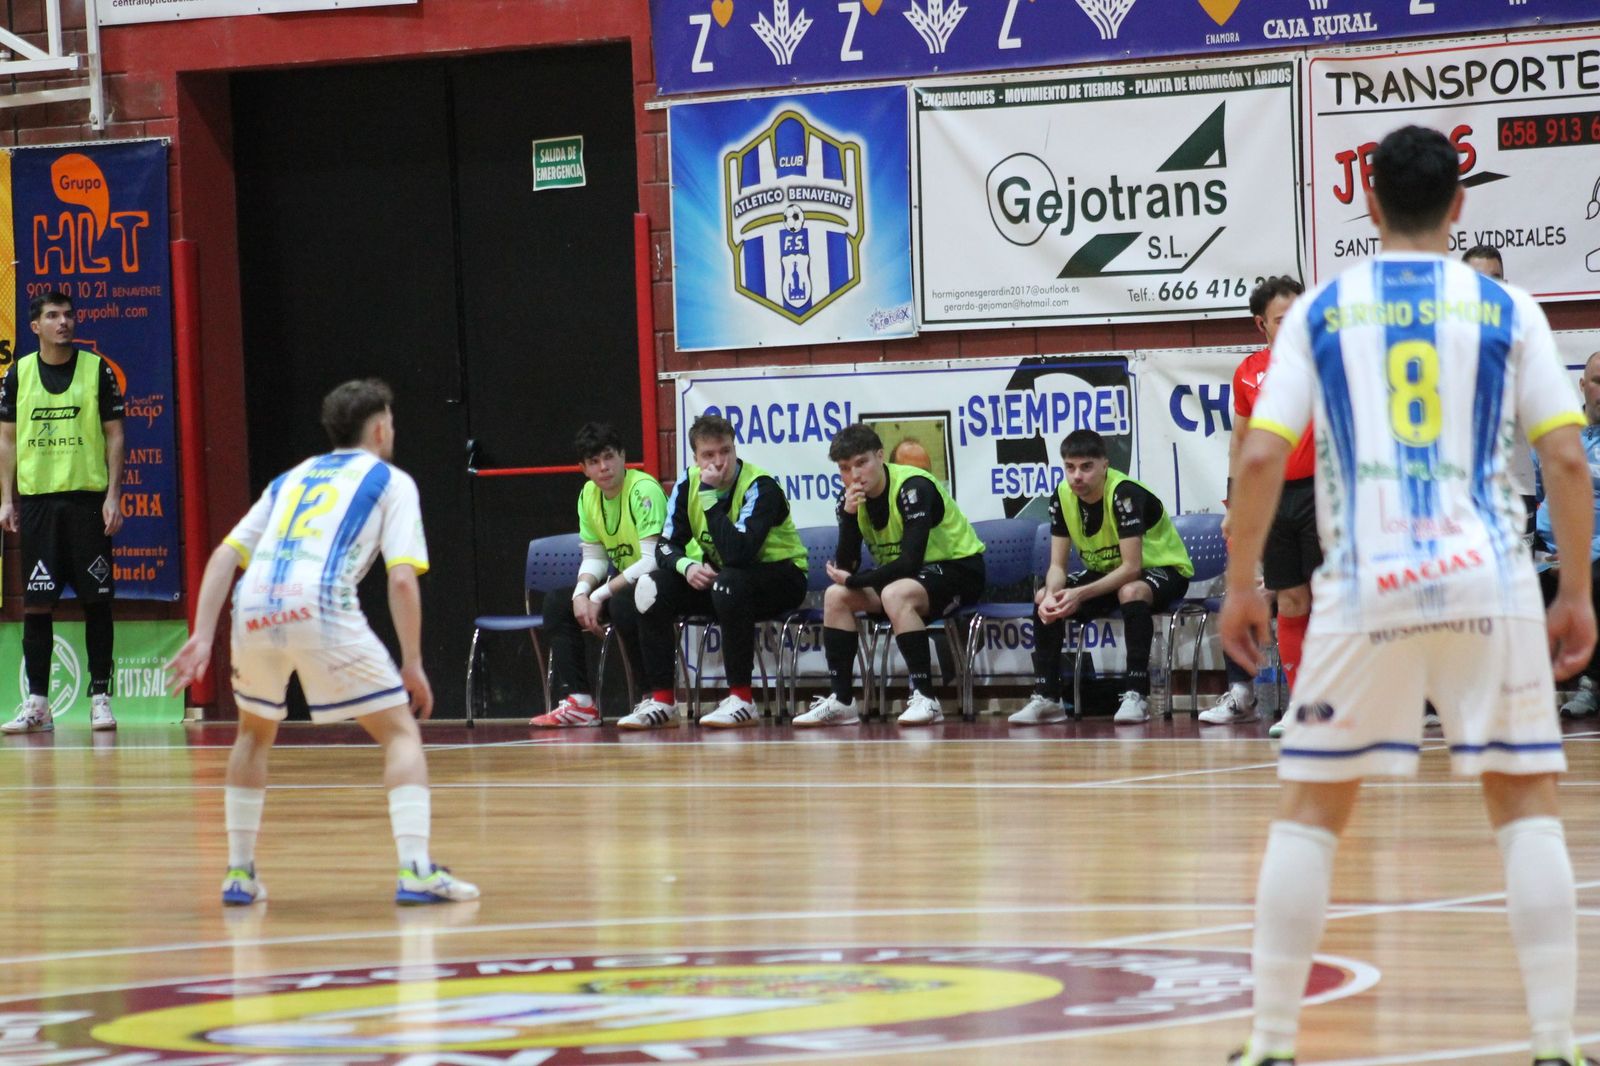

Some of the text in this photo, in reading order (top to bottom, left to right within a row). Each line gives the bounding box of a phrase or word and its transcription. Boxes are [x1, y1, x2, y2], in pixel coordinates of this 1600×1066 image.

[1205, 32, 1241, 45] ENAMORA
[1263, 12, 1378, 40] CAJA RURAL
[922, 67, 1292, 107] EXCAVACIONES MOVIMIENTO DE TIERRAS PLANTA DE HORMIGÓN Y ÁRIDOS
[1501, 120, 1537, 147] 658
[1545, 117, 1582, 143] 913
[540, 145, 577, 163] SALIDA DE
[778, 155, 804, 168] CLUB
[1333, 124, 1477, 205] JES
[59, 174, 102, 193] Grupo
[536, 163, 583, 181] EMERGENCIA
[734, 187, 853, 217] ATLETICO BENAVENTE
[997, 174, 1228, 236] Gejotrans
[33, 211, 150, 275] HLT
[1148, 236, 1188, 259] S.L.
[1474, 226, 1567, 249] VIDRIALES
[77, 281, 91, 298] 10
[94, 281, 107, 298] 21
[112, 286, 162, 297] BENAVENTE
[932, 284, 1081, 300] hormigonesgerardin2017@outlook.es
[1158, 281, 1199, 302] 666
[1206, 277, 1247, 298] 416
[944, 298, 1069, 313] gerardo-gejoman@hotmail.com
[1323, 301, 1413, 333] SERGIO
[1386, 338, 1443, 448] 8
[959, 389, 1128, 447] ¡SIEMPRE!
[28, 436, 84, 448] RENACE
[125, 448, 163, 465] ANTE
[122, 469, 143, 485] AL
[277, 482, 340, 540] 12
[1376, 548, 1485, 596] MACIAS
[27, 582, 55, 591] ACTIO
[246, 607, 312, 633] MACIAS
[986, 622, 1117, 650] ROSEDA
[117, 668, 168, 698] FUTSAL
